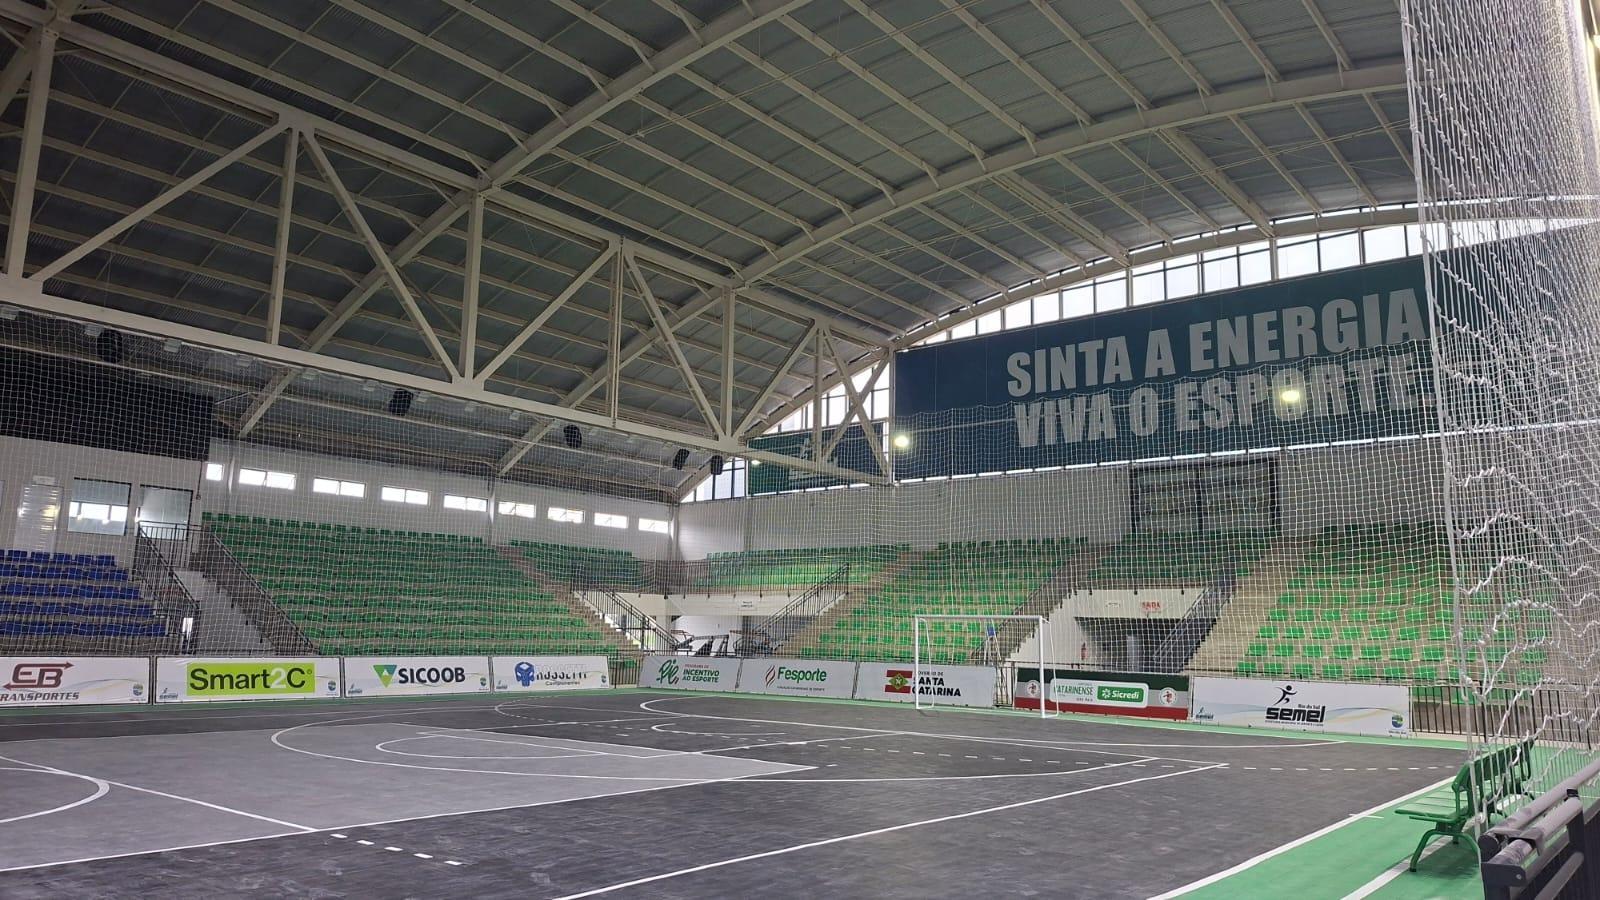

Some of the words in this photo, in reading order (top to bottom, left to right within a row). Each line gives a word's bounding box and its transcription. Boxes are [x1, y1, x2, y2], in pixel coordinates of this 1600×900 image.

[1006, 335, 1133, 397] SINTA
[1144, 328, 1176, 378] A
[1189, 288, 1426, 372] ENERGIA
[1014, 393, 1117, 448] VIVA
[1129, 387, 1158, 436] O
[1174, 352, 1438, 431] ESPORTE
[398, 667, 466, 684] SICOOB
[683, 669, 720, 677] INCENTIVO
[777, 666, 827, 684] Fesporte
[913, 677, 945, 686] ANTA
[0, 692, 80, 702] RANSPORTES
[1112, 691, 1139, 699] Sicredi
[1266, 706, 1326, 723] semel
